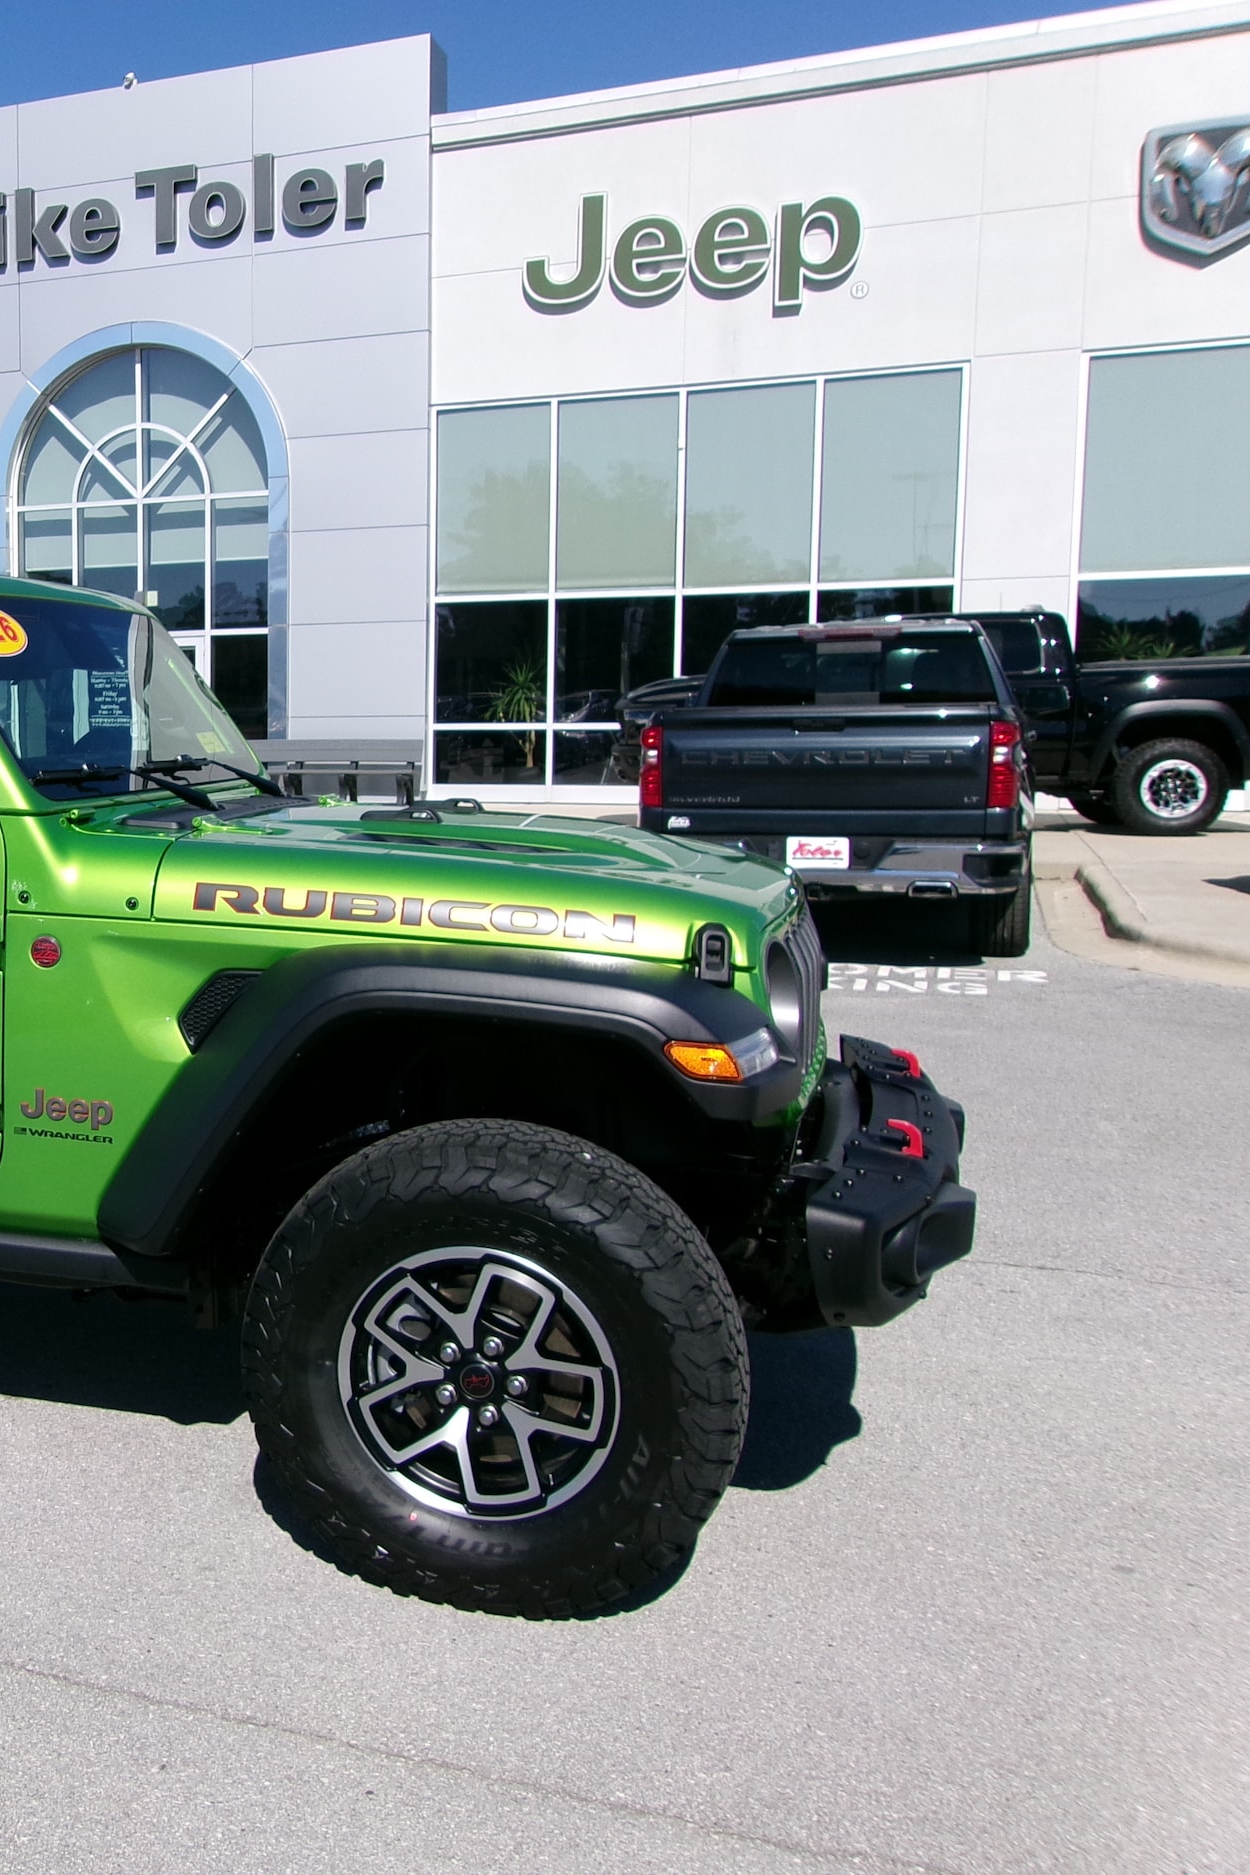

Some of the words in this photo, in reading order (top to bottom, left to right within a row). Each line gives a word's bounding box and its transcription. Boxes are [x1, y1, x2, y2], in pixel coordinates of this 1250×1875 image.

[135, 153, 385, 246] Toler
[522, 192, 865, 310] Jeep
[681, 749, 967, 765] CHEVROLET
[192, 882, 637, 944] RUBICON
[20, 1087, 114, 1131] Jeep
[28, 1127, 114, 1144] WRANGLER
